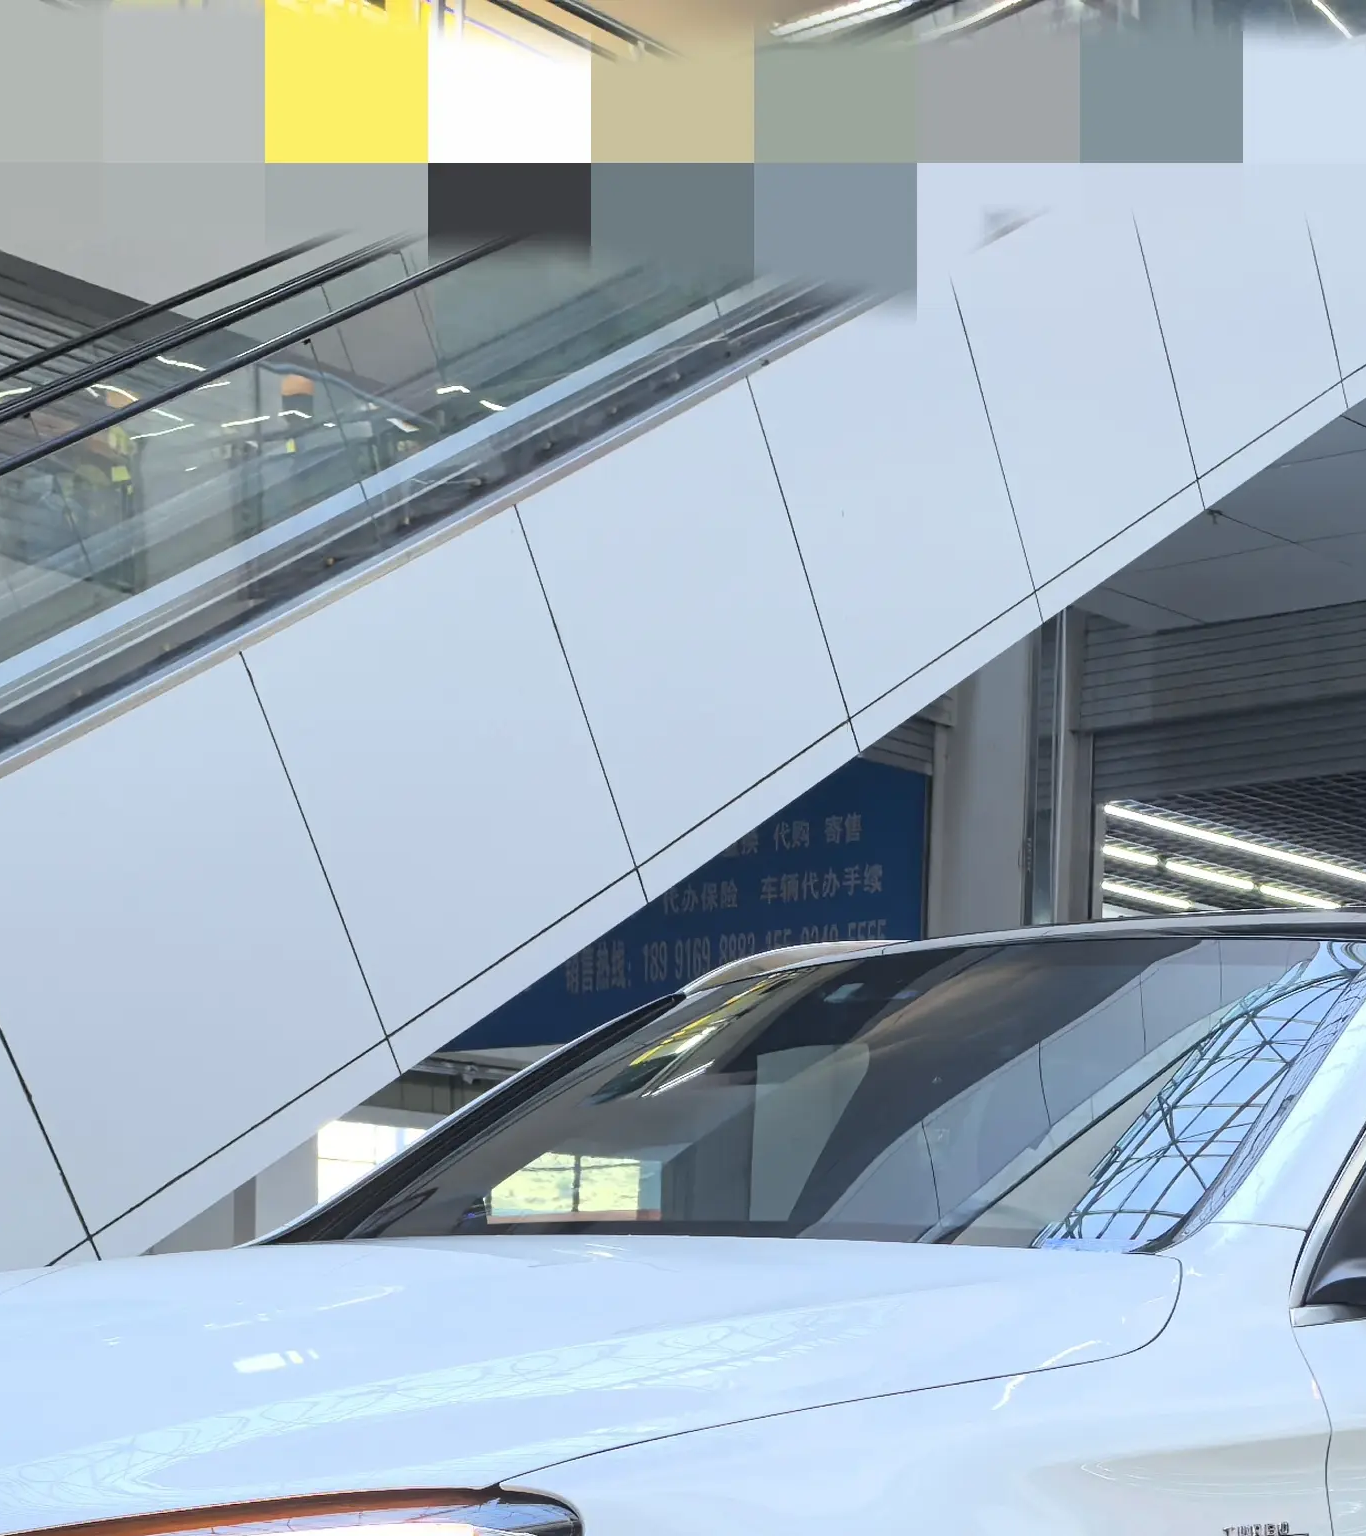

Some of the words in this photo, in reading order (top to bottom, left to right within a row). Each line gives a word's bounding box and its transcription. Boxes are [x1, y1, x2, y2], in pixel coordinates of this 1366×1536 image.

[773, 821, 810, 850] 代购
[824, 812, 863, 845] 寄售
[663, 878, 738, 915] 代办保险
[760, 863, 884, 904] 车辆代办手续
[642, 940, 668, 984] 189
[674, 936, 711, 981] 9169
